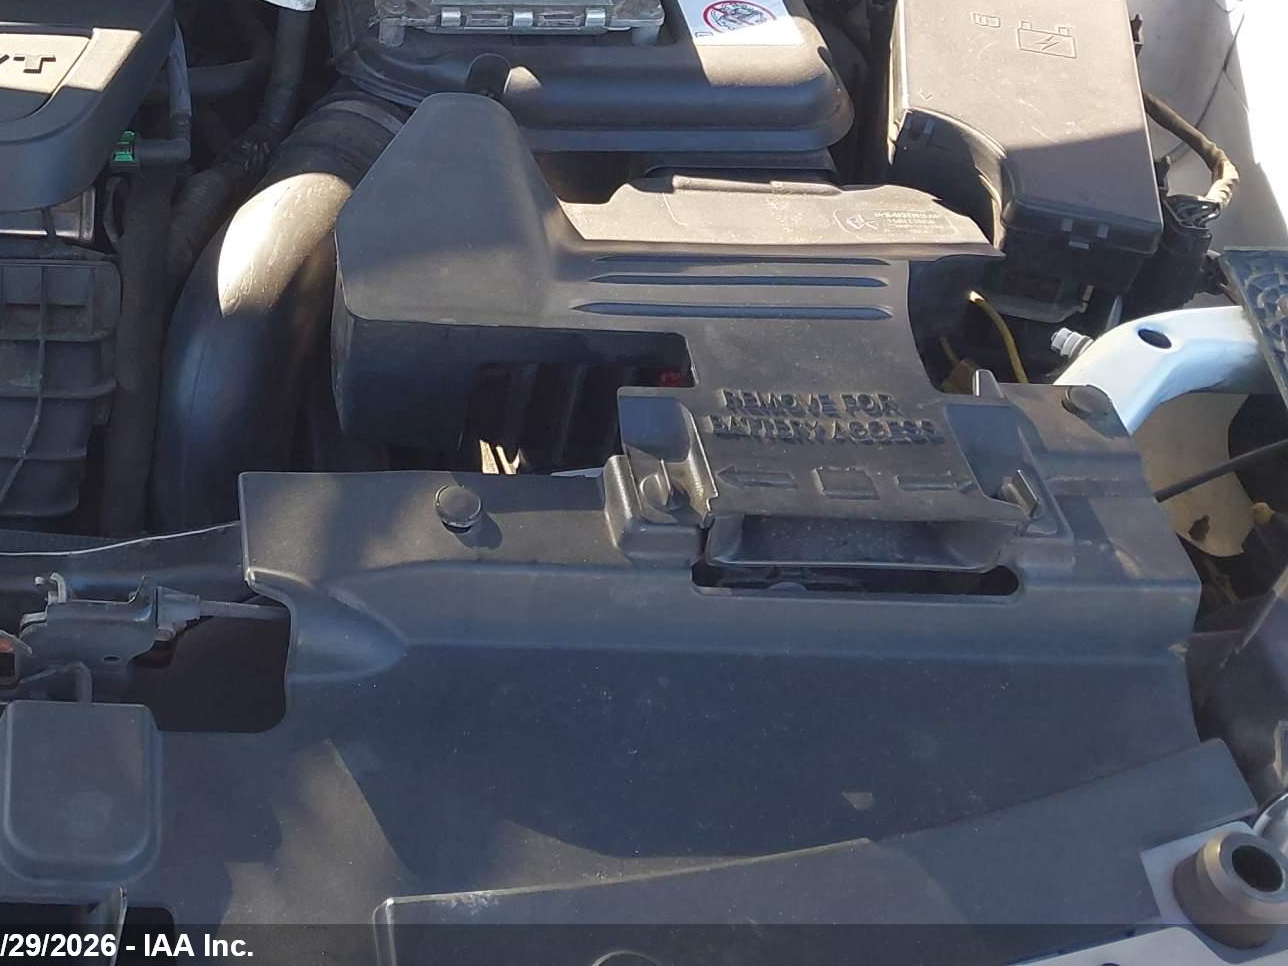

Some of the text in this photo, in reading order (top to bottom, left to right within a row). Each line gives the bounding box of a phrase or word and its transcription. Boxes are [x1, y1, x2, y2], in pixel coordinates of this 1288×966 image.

[721, 388, 903, 417] REMOVE FOR
[708, 415, 944, 444] BATTERY ACCESS
